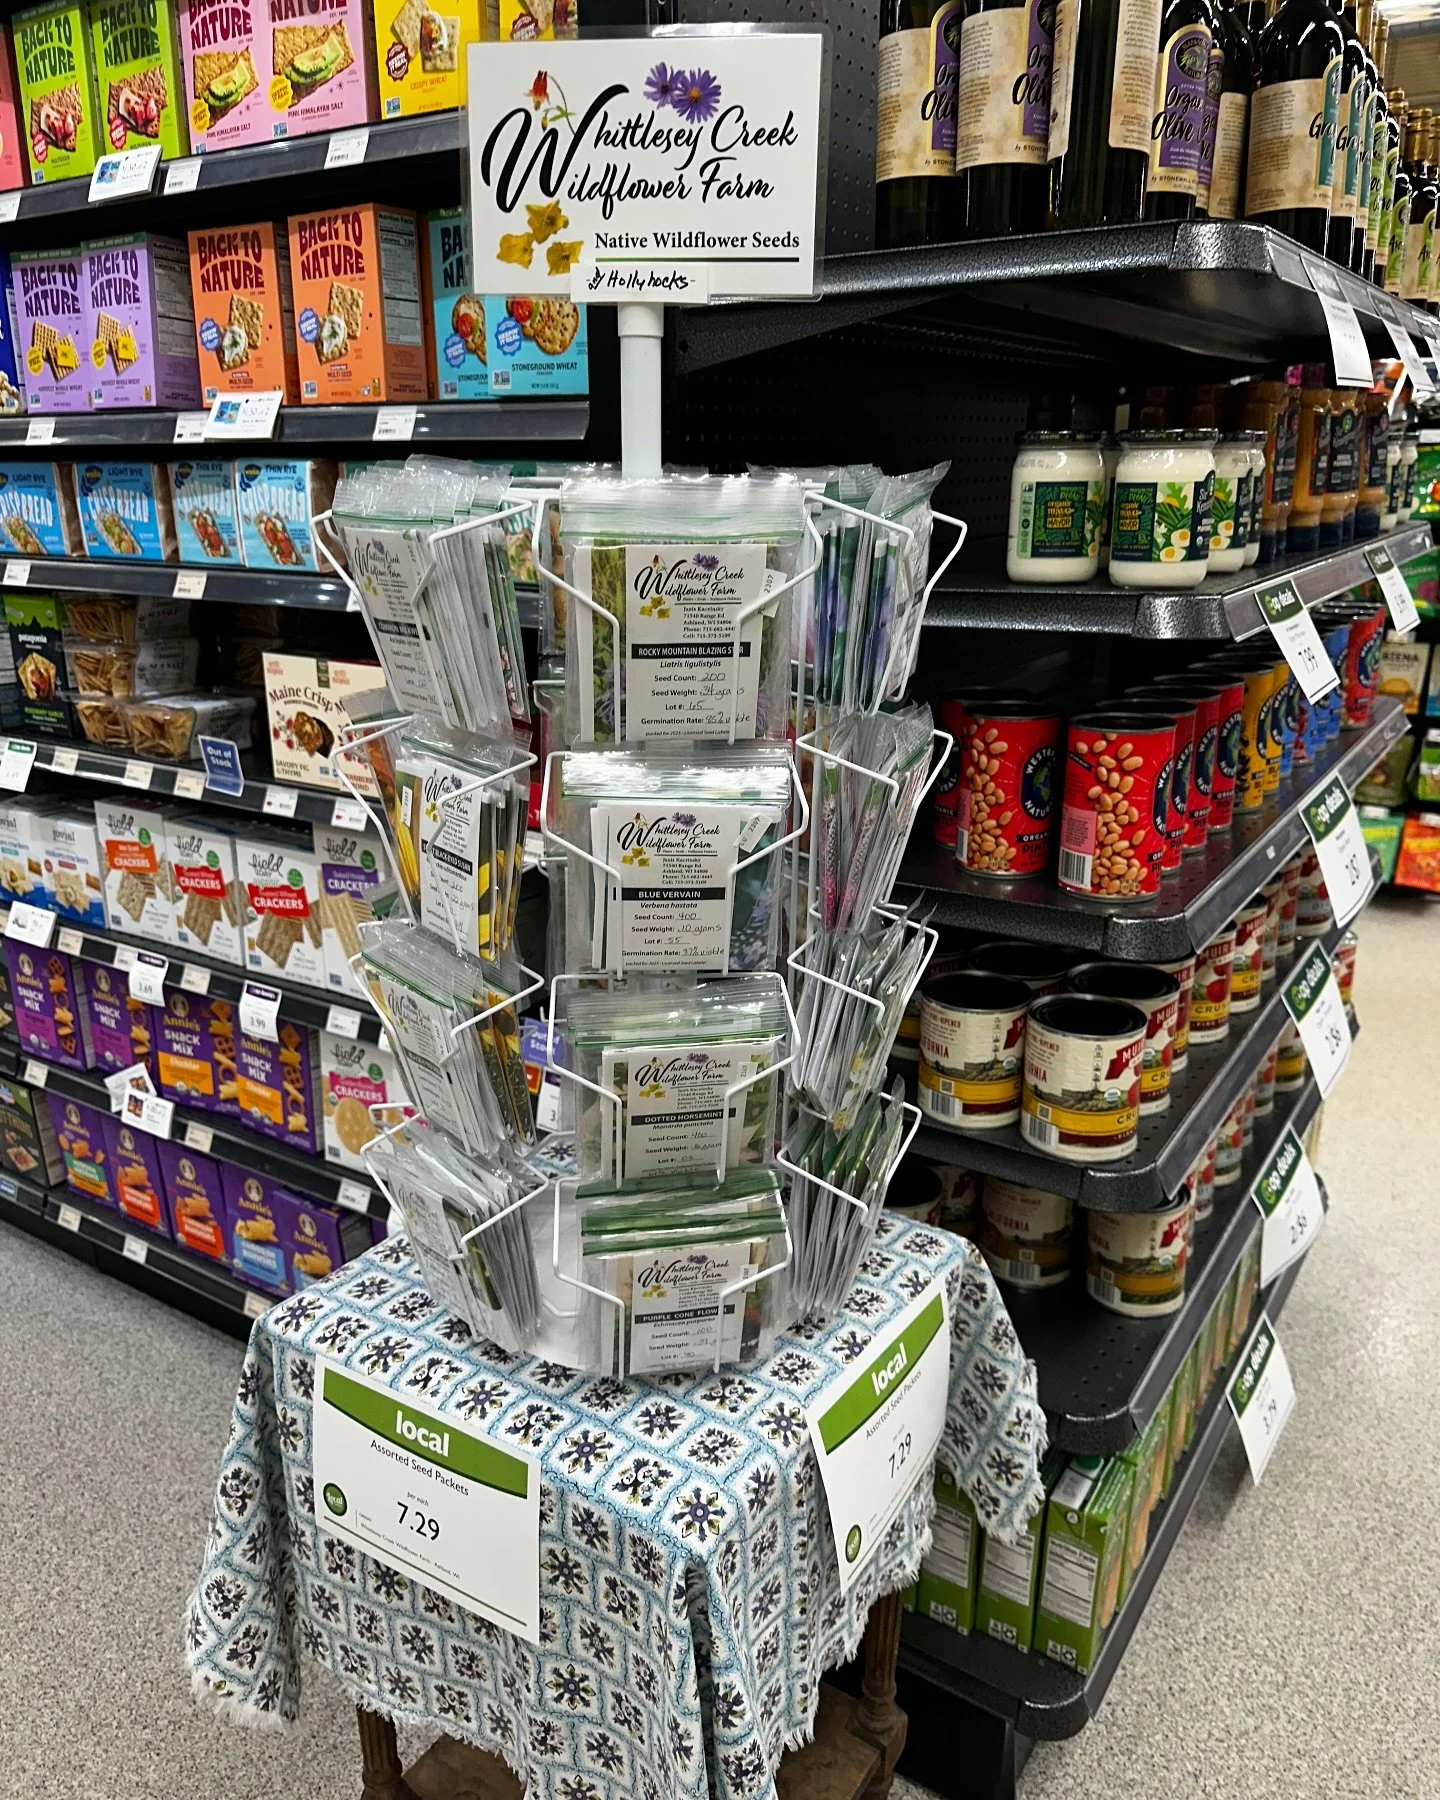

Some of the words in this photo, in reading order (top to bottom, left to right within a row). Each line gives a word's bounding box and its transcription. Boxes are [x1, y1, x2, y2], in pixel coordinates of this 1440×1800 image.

[101, 4, 134, 43] BACK
[139, 0, 158, 30] TO
[190, 8, 253, 51] NATURE
[20, 21, 52, 60] BACK
[55, 15, 73, 48] TO
[104, 27, 161, 68] NATURE
[25, 46, 76, 85] NATURE
[329, 101, 344, 112] SALT
[711, 105, 798, 152] Creek
[1151, 111, 1195, 142] Olive
[700, 157, 774, 203] Farm
[298, 215, 339, 254] BACK
[341, 211, 363, 248] TO
[595, 232, 648, 249] Native
[653, 231, 748, 249] Wildflower
[752, 231, 800, 249] Seeds
[197, 232, 238, 270] BACK
[240, 230, 263, 264] TO
[89, 252, 120, 285] BACK
[122, 249, 139, 279] TO
[301, 244, 366, 281] NATURE
[20, 265, 57, 298] BACK
[59, 262, 78, 293] TO
[201, 259, 265, 293] NATURE
[91, 277, 141, 309] NATURE
[25, 288, 81, 318] NATURE
[511, 362, 555, 372] STONEGROUND
[556, 362, 578, 371] WHEAT
[265, 464, 282, 473] THIN
[283, 464, 297, 474] RYE
[714, 566, 745, 581] Creek
[711, 581, 736, 597] Farm
[18, 634, 48, 644] patagonia
[638, 648, 661, 656] ROCKY
[662, 647, 698, 656] MOUNTAIN
[698, 646, 727, 655] BLAZING
[727, 646, 744, 655] STR
[660, 660, 683, 669] Liatris
[684, 660, 722, 669] ligulistylis
[673, 674, 697, 682] Count:
[269, 685, 302, 705] Maine
[304, 686, 333, 713] Crisp
[670, 689, 698, 698] Weight:
[207, 745, 223, 758] Out
[224, 750, 233, 760] of
[210, 756, 234, 769] Stock
[52, 829, 76, 841] jovial
[692, 823, 721, 837] Creek
[689, 837, 712, 850] Farm
[114, 856, 151, 868] CRACKERS
[180, 876, 221, 890] CRACKERS
[254, 897, 304, 910] CRACKERS
[649, 926, 675, 934] Weight:
[705, 1059, 731, 1074] Creek
[335, 1085, 384, 1102] CRACKERS
[645, 1114, 677, 1122] DOTTED
[678, 1111, 722, 1121] HORSEMINT
[643, 1313, 672, 1322] PURPLE
[674, 1311, 695, 1319] CONE
[871, 1341, 908, 1396] local
[866, 1405, 891, 1440] Assorted
[890, 1390, 905, 1411] Seed
[904, 1369, 922, 1395] Packets
[395, 1410, 450, 1457] local
[888, 1432, 912, 1479] 7.29
[370, 1439, 410, 1466] Assorted
[411, 1459, 433, 1478] Seed
[435, 1470, 470, 1496] Packets
[397, 1501, 440, 1541] 7.29
